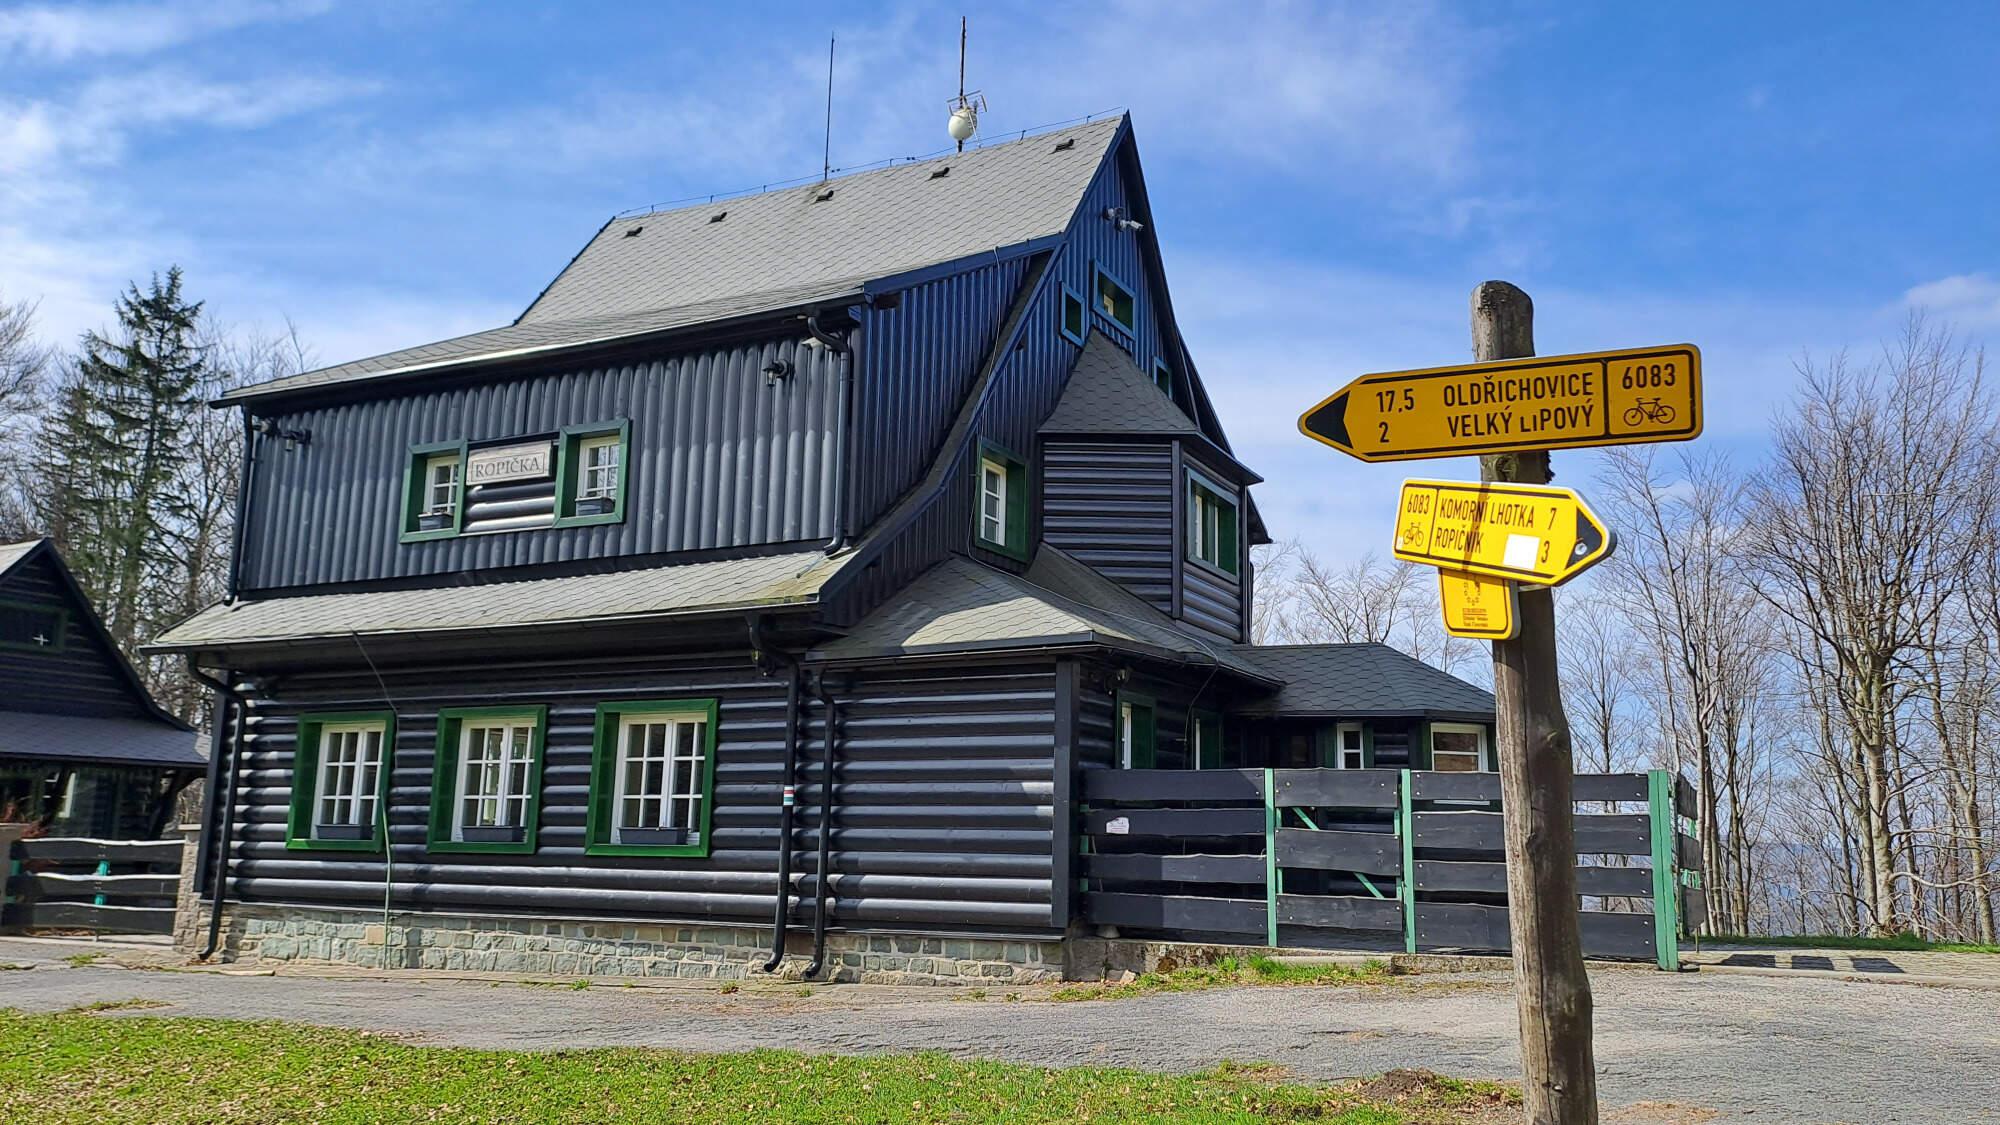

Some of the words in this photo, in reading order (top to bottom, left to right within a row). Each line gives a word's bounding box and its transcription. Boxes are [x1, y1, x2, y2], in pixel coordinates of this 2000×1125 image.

[1443, 371, 1594, 408] OLDŘICHOVICE
[1622, 363, 1676, 390] 6083
[1378, 421, 1390, 443] 2
[1447, 405, 1513, 438] VELKÝ
[1520, 398, 1594, 433] LIPOVÝ
[475, 457, 540, 478] ROPIČKA
[1407, 494, 1430, 515] 6083
[1440, 495, 1491, 523] KOMORNÍ
[1490, 502, 1535, 528] LHOTKA
[1547, 507, 1557, 530] 7
[1435, 524, 1484, 554] ROPIČNÍK
[1541, 540, 1550, 563] 3
